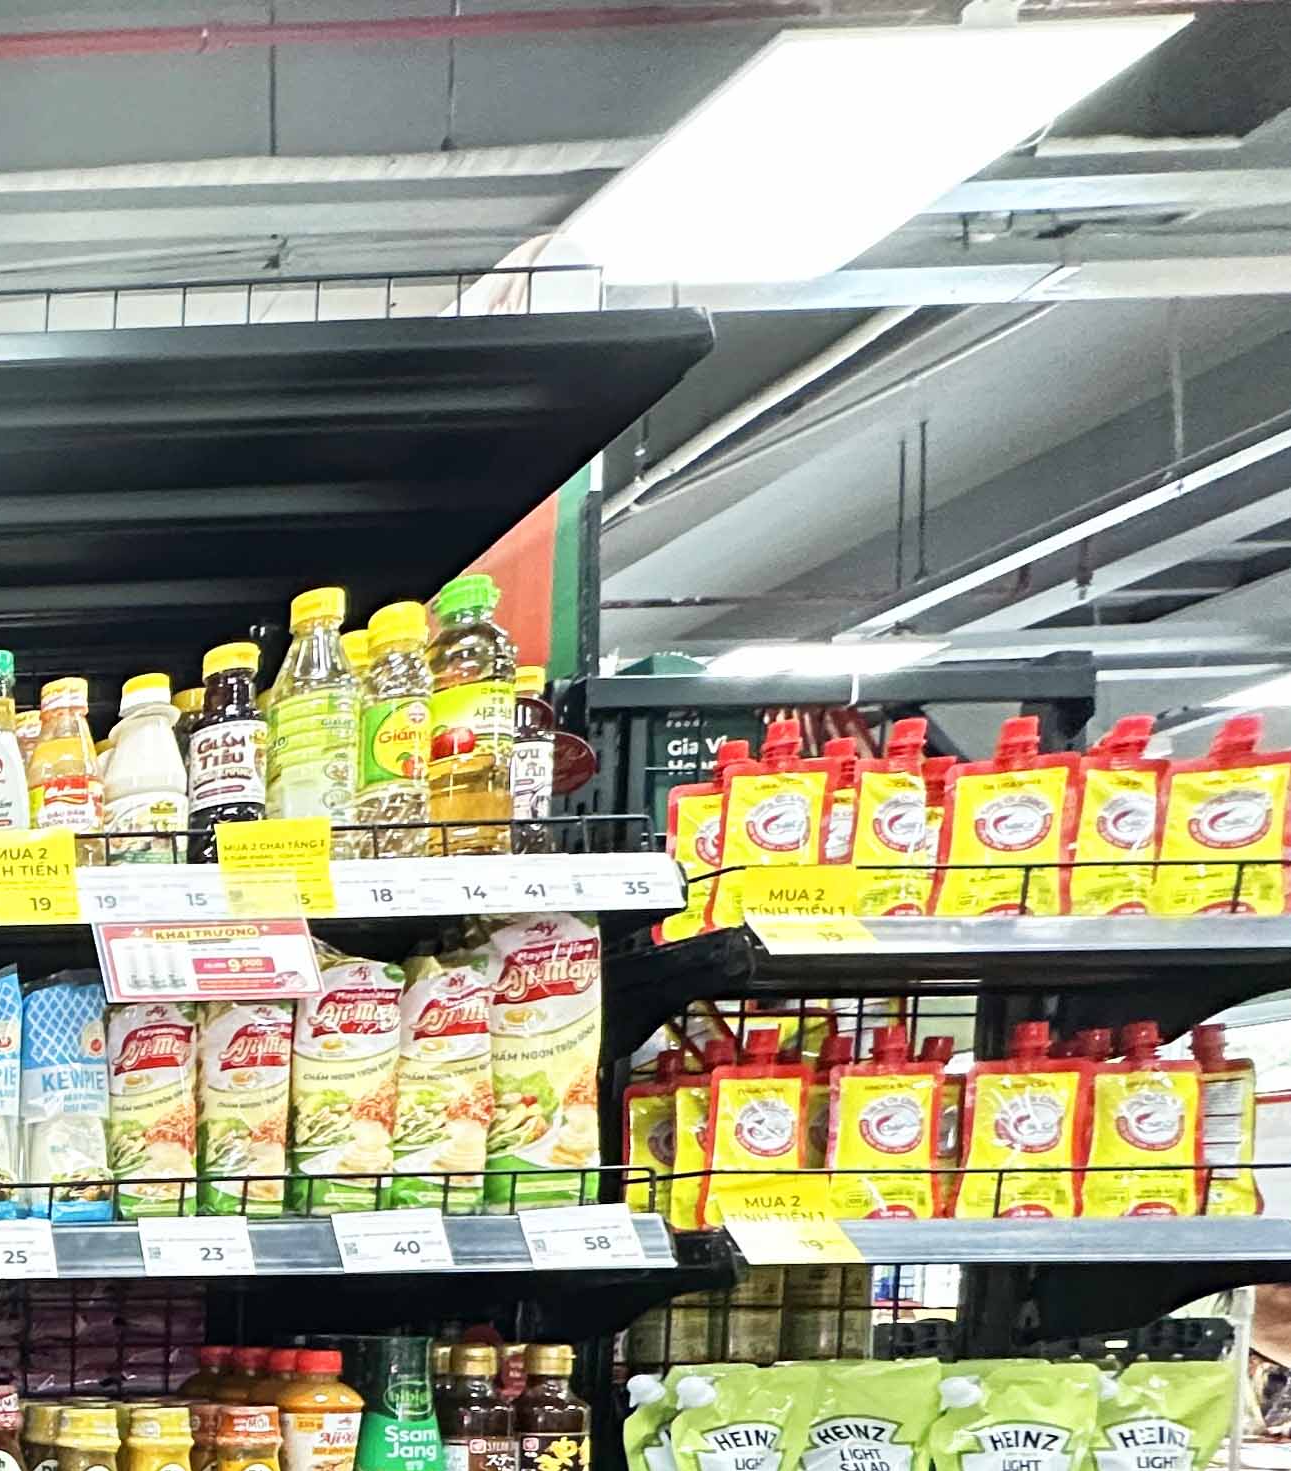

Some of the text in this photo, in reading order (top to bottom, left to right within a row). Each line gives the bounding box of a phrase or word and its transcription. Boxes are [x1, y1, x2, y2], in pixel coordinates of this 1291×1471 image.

[38, 848, 47, 859] 2
[64, 864, 69, 875] 1
[371, 888, 393, 902] 18
[625, 881, 650, 895] 35
[769, 888, 825, 902] MUA 2
[30, 897, 51, 911] 19
[42, 1070, 104, 1090] KEWPIE
[584, 1236, 611, 1250] 58
[200, 1247, 224, 1261] 23
[384, 1425, 437, 1441] Ssam
[991, 1432, 1060, 1451] HEINZ
[386, 1440, 436, 1461] Jang
